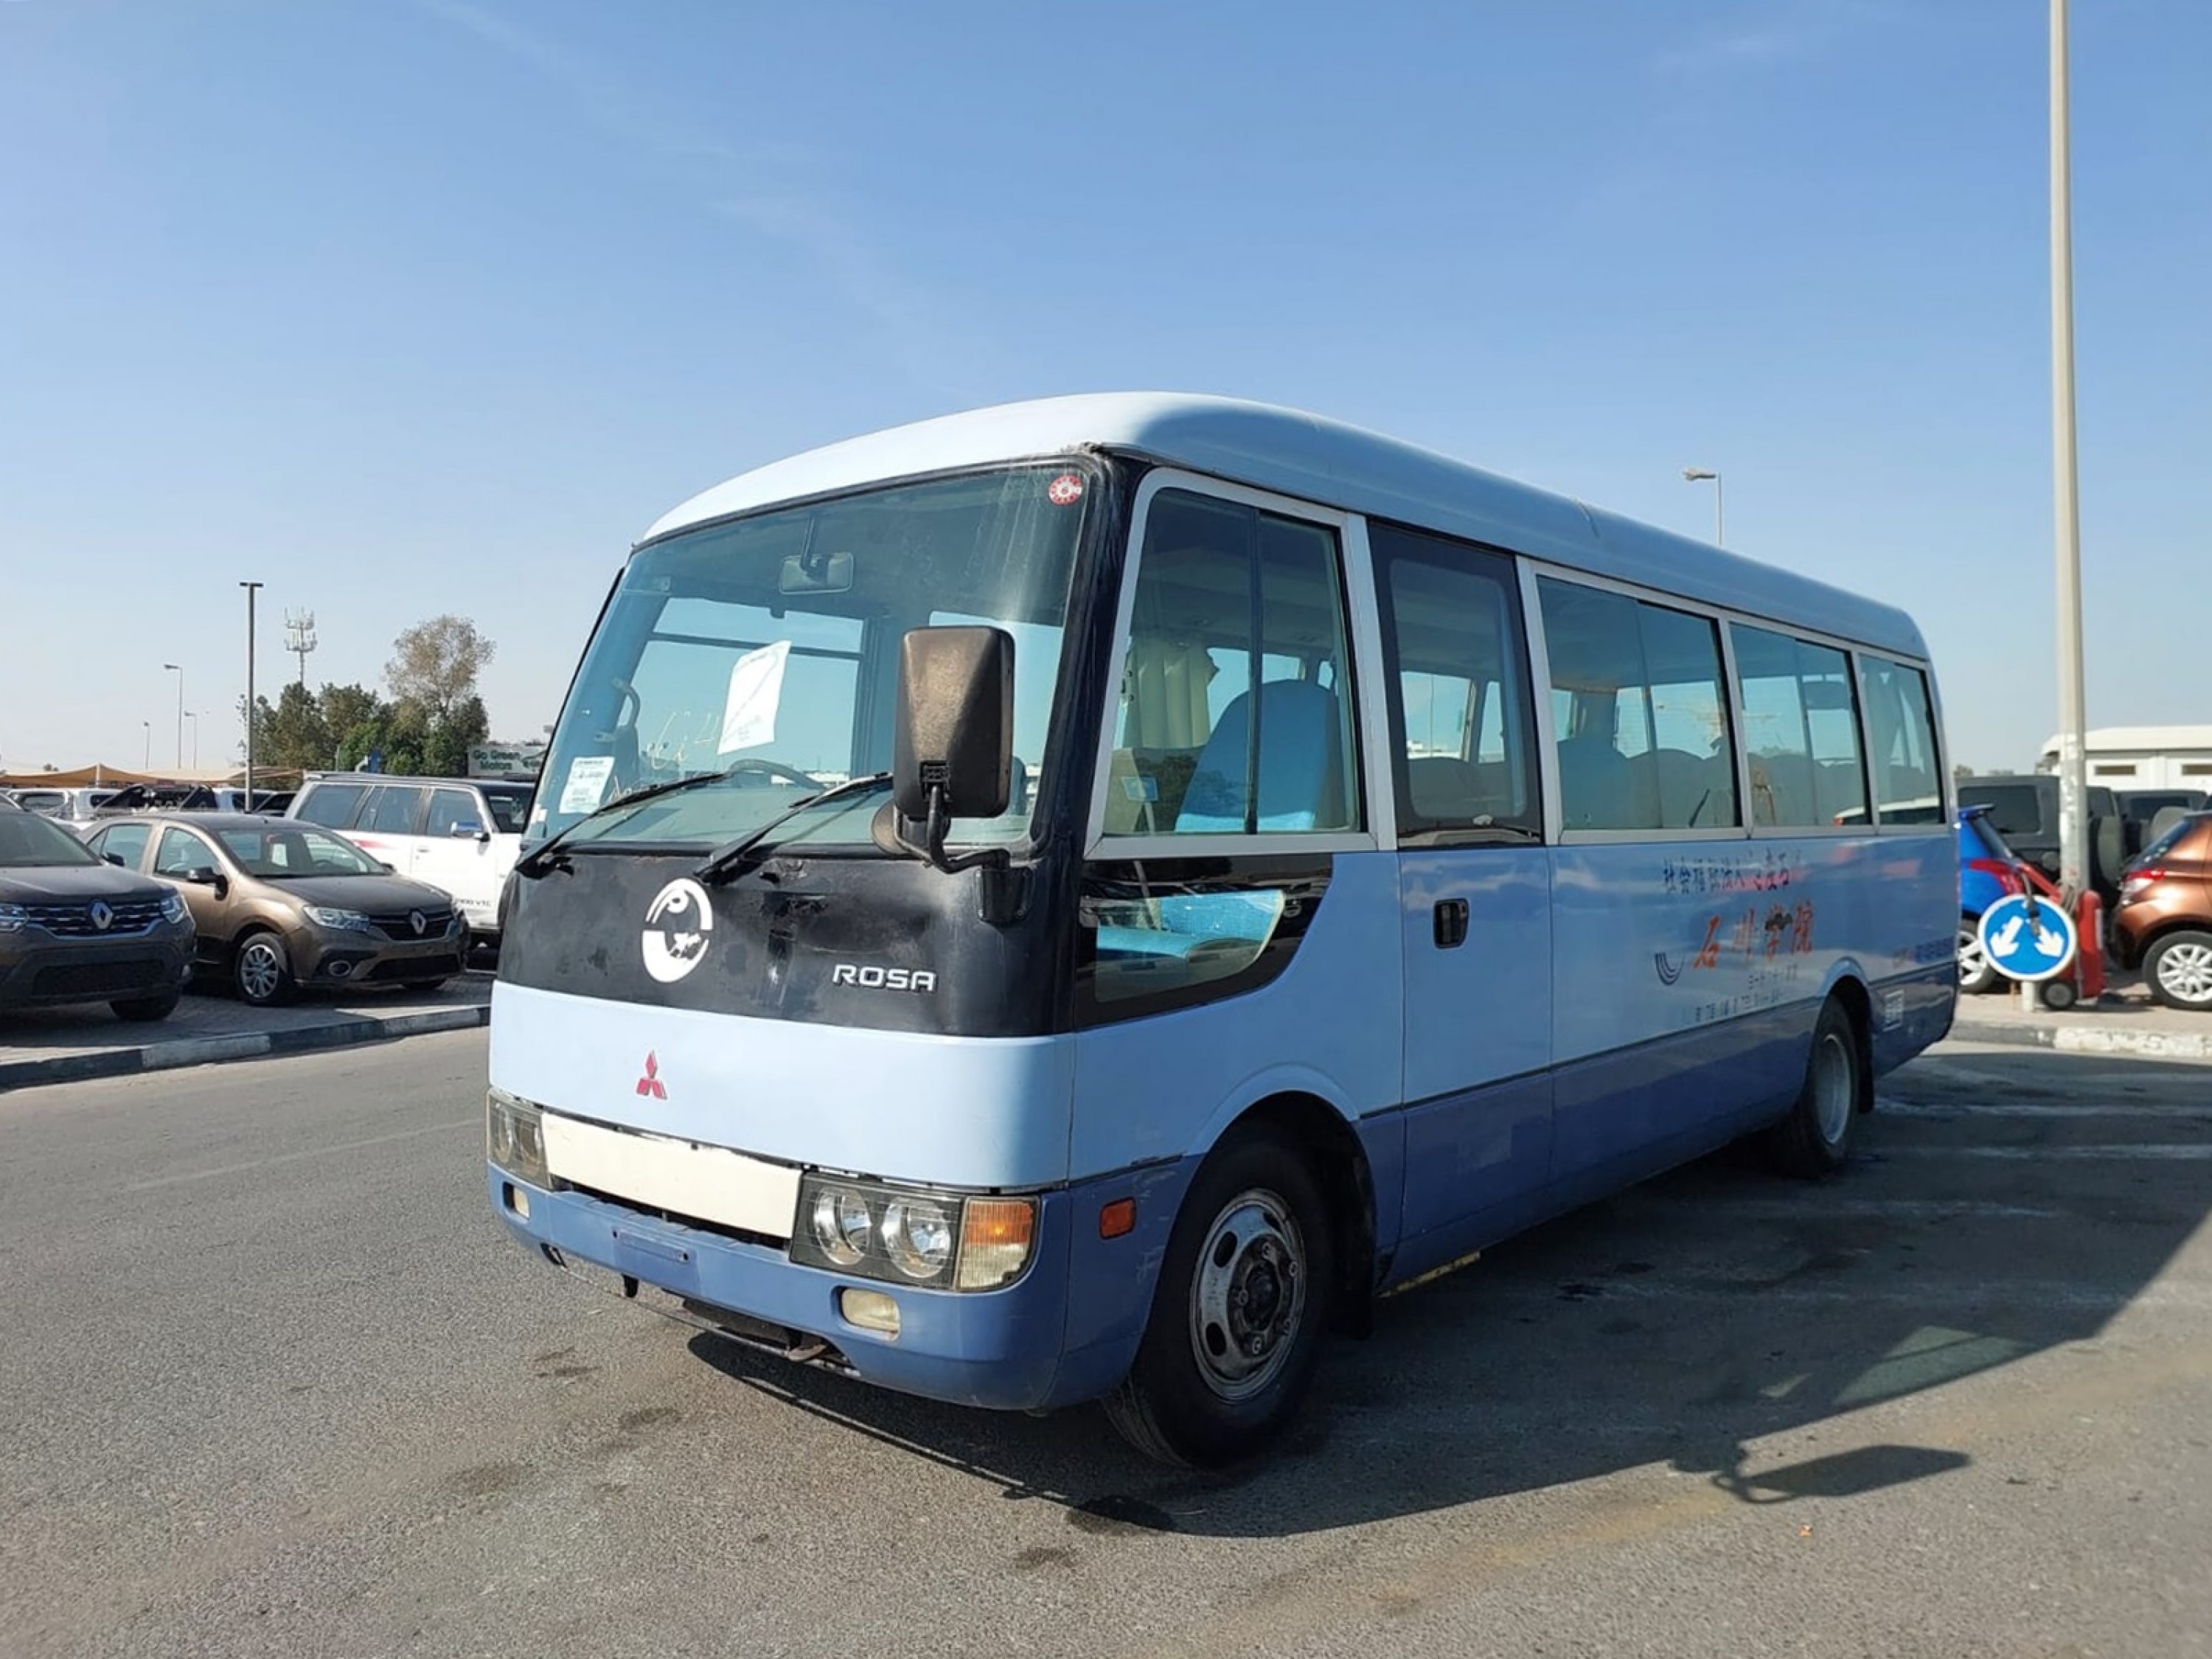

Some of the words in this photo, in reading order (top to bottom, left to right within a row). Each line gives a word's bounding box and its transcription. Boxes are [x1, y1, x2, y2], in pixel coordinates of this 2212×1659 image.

[472, 749, 487, 760] Go
[490, 749, 521, 760] Green
[832, 963, 937, 992] ROSA
